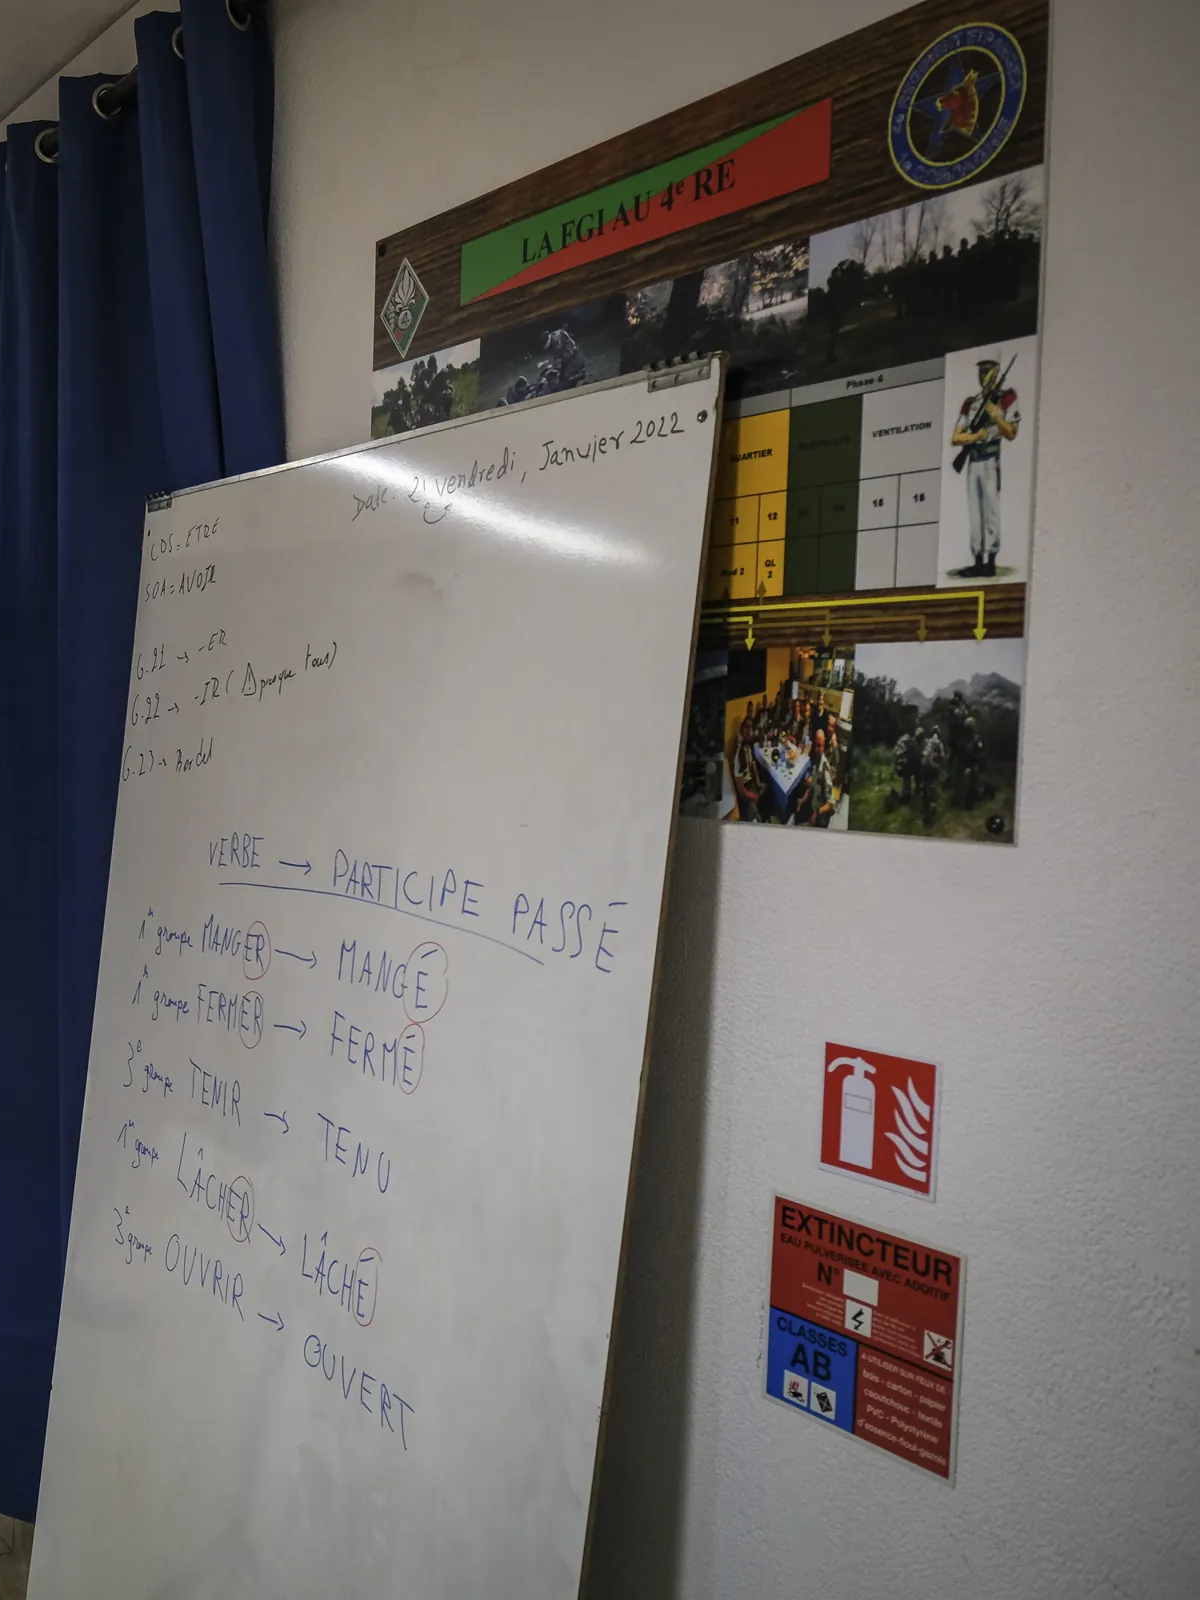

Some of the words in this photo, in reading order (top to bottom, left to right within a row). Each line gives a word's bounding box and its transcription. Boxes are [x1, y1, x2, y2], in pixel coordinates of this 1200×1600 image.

[521, 229, 553, 264] LA
[560, 208, 605, 249] FGI
[612, 190, 652, 232] AU
[693, 158, 736, 202] RE
[845, 377, 875, 390] Phase
[877, 374, 884, 383] 4
[630, 412, 685, 445] 2022
[872, 421, 933, 438] VENTILATION
[729, 448, 773, 463] QUARTIER
[767, 511, 778, 521] 12
[872, 498, 884, 508] 15
[739, 567, 745, 576] 2
[764, 559, 777, 568] QL
[766, 570, 773, 579] 2
[208, 831, 265, 870] VERBE
[333, 848, 485, 917] PARTICIPE
[512, 893, 629, 974] PASSÉ
[202, 913, 266, 973] MANGER
[338, 939, 440, 1010] MANGÉ
[197, 983, 263, 1036] FERMER
[330, 1010, 416, 1087] FERMÉ
[189, 1057, 241, 1127] TENIR
[317, 1111, 392, 1194] TENU
[177, 1131, 251, 1245] LÂCHER
[301, 1231, 375, 1319] LÂCHÉ
[781, 1205, 953, 1287] EXTINCTEUR
[780, 1232, 801, 1248] EAU
[804, 1241, 869, 1273] PULVERISEE
[871, 1266, 901, 1285] AVEC
[904, 1279, 952, 1302] ADDITIF
[817, 1261, 841, 1287] N°
[165, 1233, 245, 1323] OUVRIR
[304, 1334, 415, 1452] OUVERT
[776, 1315, 848, 1358] CLASSES
[790, 1343, 832, 1382] AB
[867, 1354, 899, 1374] UTILISER
[899, 1368, 915, 1381] SUR
[862, 1368, 880, 1383] bois
[886, 1381, 913, 1397] carton
[919, 1395, 946, 1412] papier
[863, 1388, 911, 1414] caoutchouc
[917, 1411, 944, 1429] textile
[866, 1404, 884, 1420] PVC
